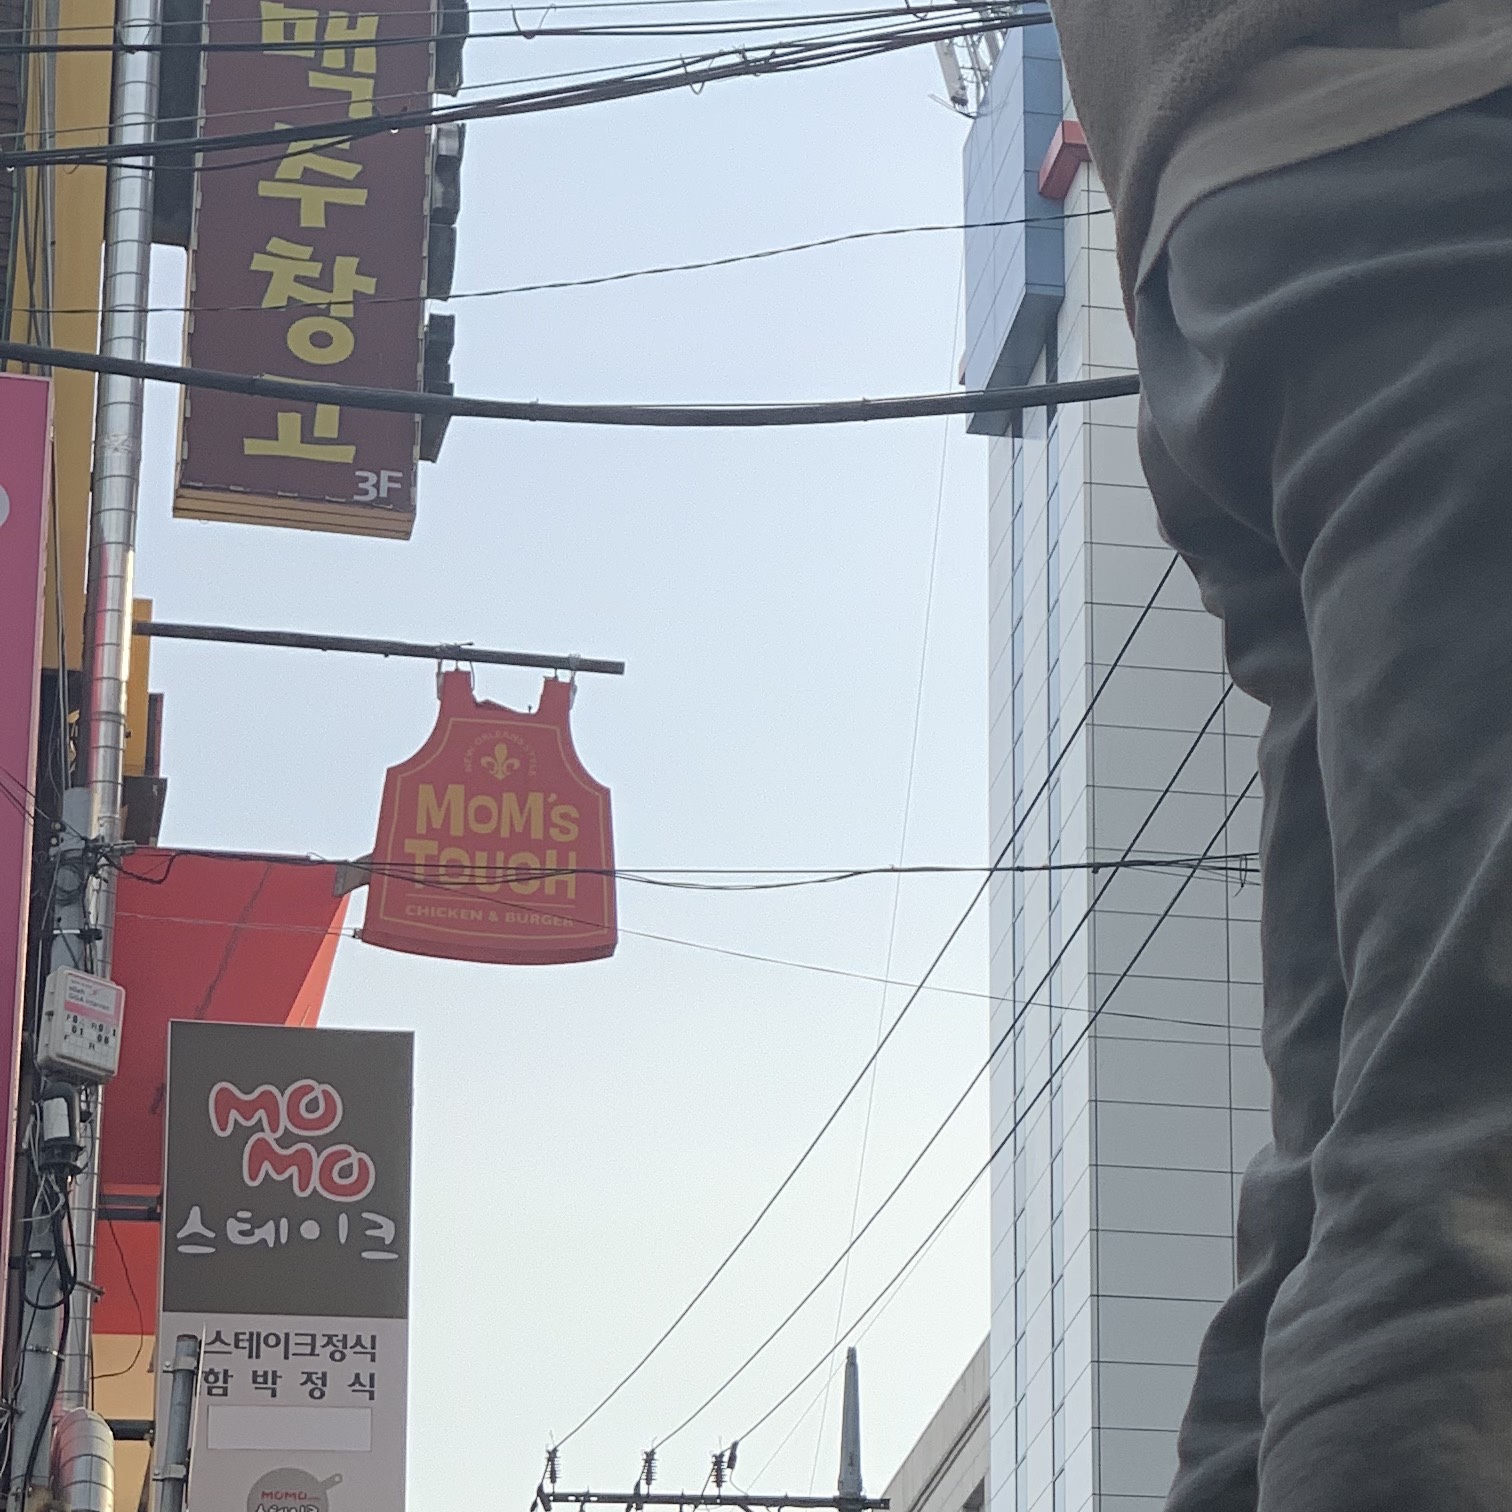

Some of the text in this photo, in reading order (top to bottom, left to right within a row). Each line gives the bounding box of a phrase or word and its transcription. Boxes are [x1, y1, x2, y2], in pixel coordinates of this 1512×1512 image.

[243, 0, 380, 464] 맥주창고
[353, 469, 404, 501] 3F
[404, 838, 577, 899] TOUCH
[405, 904, 575, 928] CHICKEN & BURGER
[176, 1205, 399, 1260] 스테이크
[203, 1329, 378, 1363] 스테이크정식
